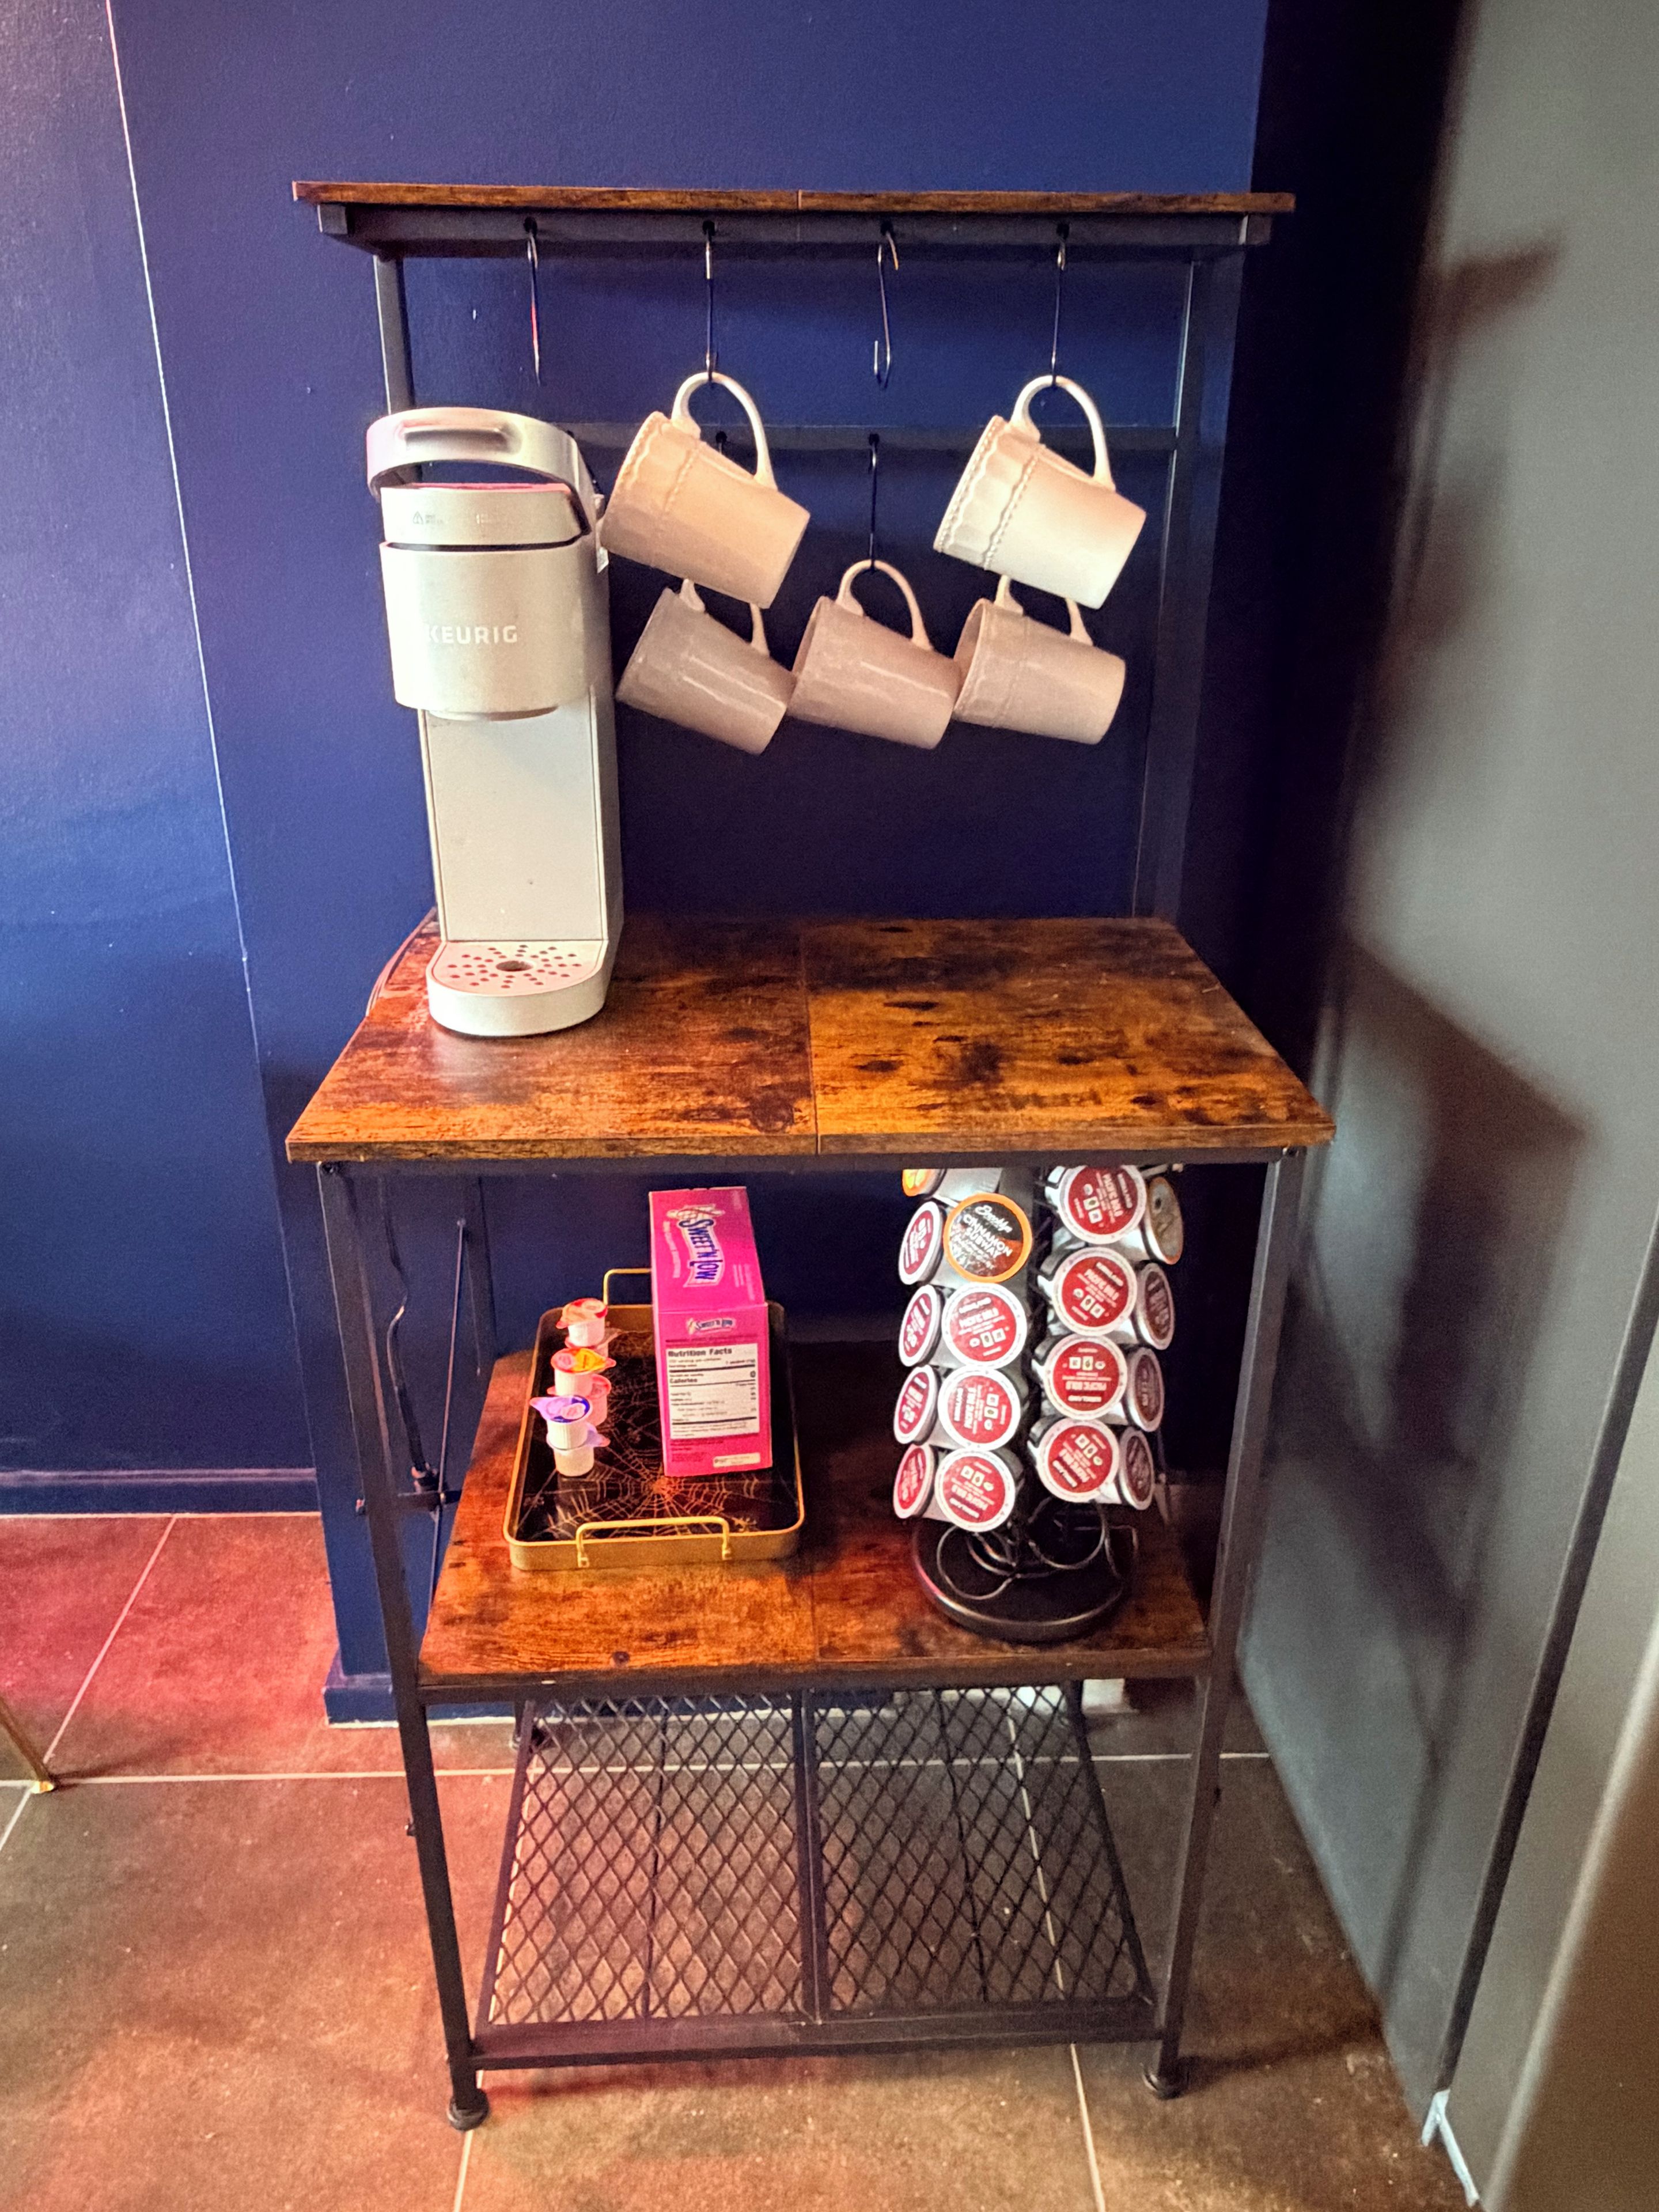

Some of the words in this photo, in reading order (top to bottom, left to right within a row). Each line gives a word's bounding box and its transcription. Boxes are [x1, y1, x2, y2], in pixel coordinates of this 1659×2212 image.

[427, 625, 517, 644] KEURIG
[963, 1214, 1013, 1256] CINNAMON
[965, 1227, 1002, 1259] SUBWAY
[690, 1260, 723, 1279] LOW
